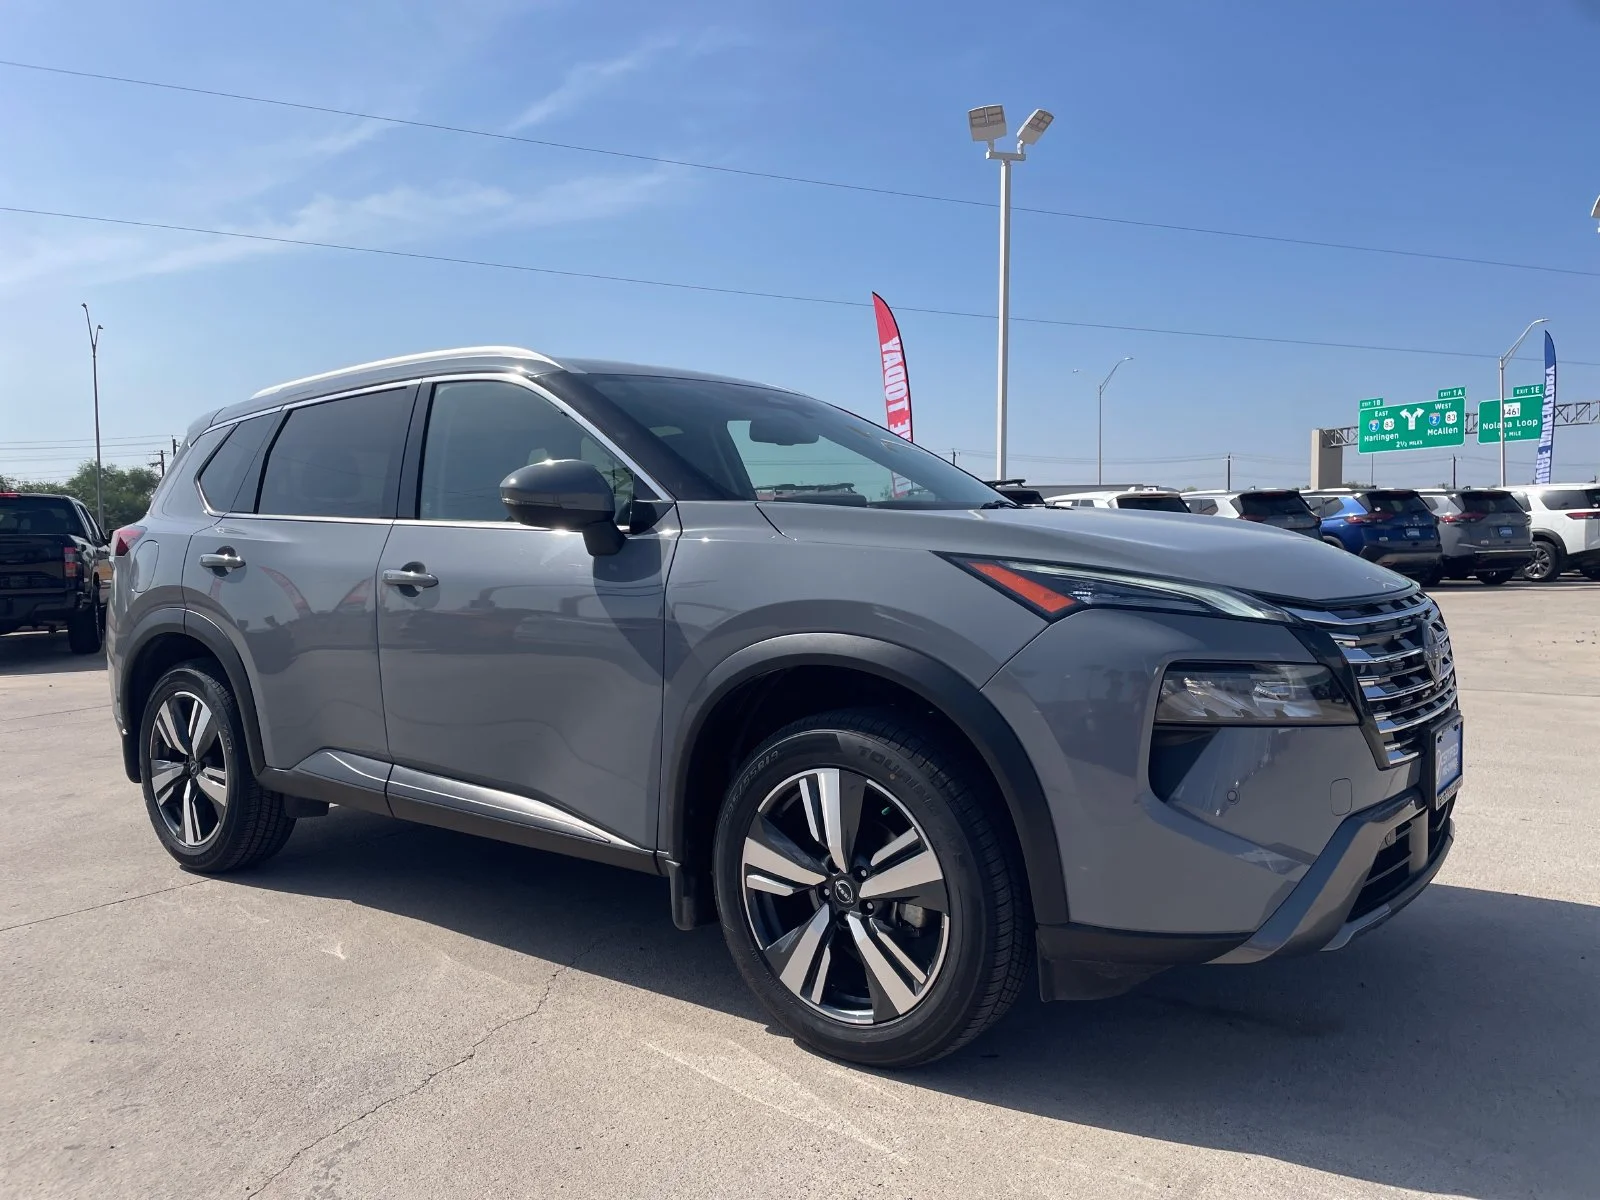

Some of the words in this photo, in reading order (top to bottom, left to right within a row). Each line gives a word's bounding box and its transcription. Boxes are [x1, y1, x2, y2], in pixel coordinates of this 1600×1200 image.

[1531, 386, 1540, 394] 1E
[1503, 408, 1520, 416] 461
[1447, 413, 1456, 422] 83
[1517, 419, 1538, 427] Loop
[1427, 427, 1458, 436] McAllen
[1364, 433, 1399, 442] Harlingen
